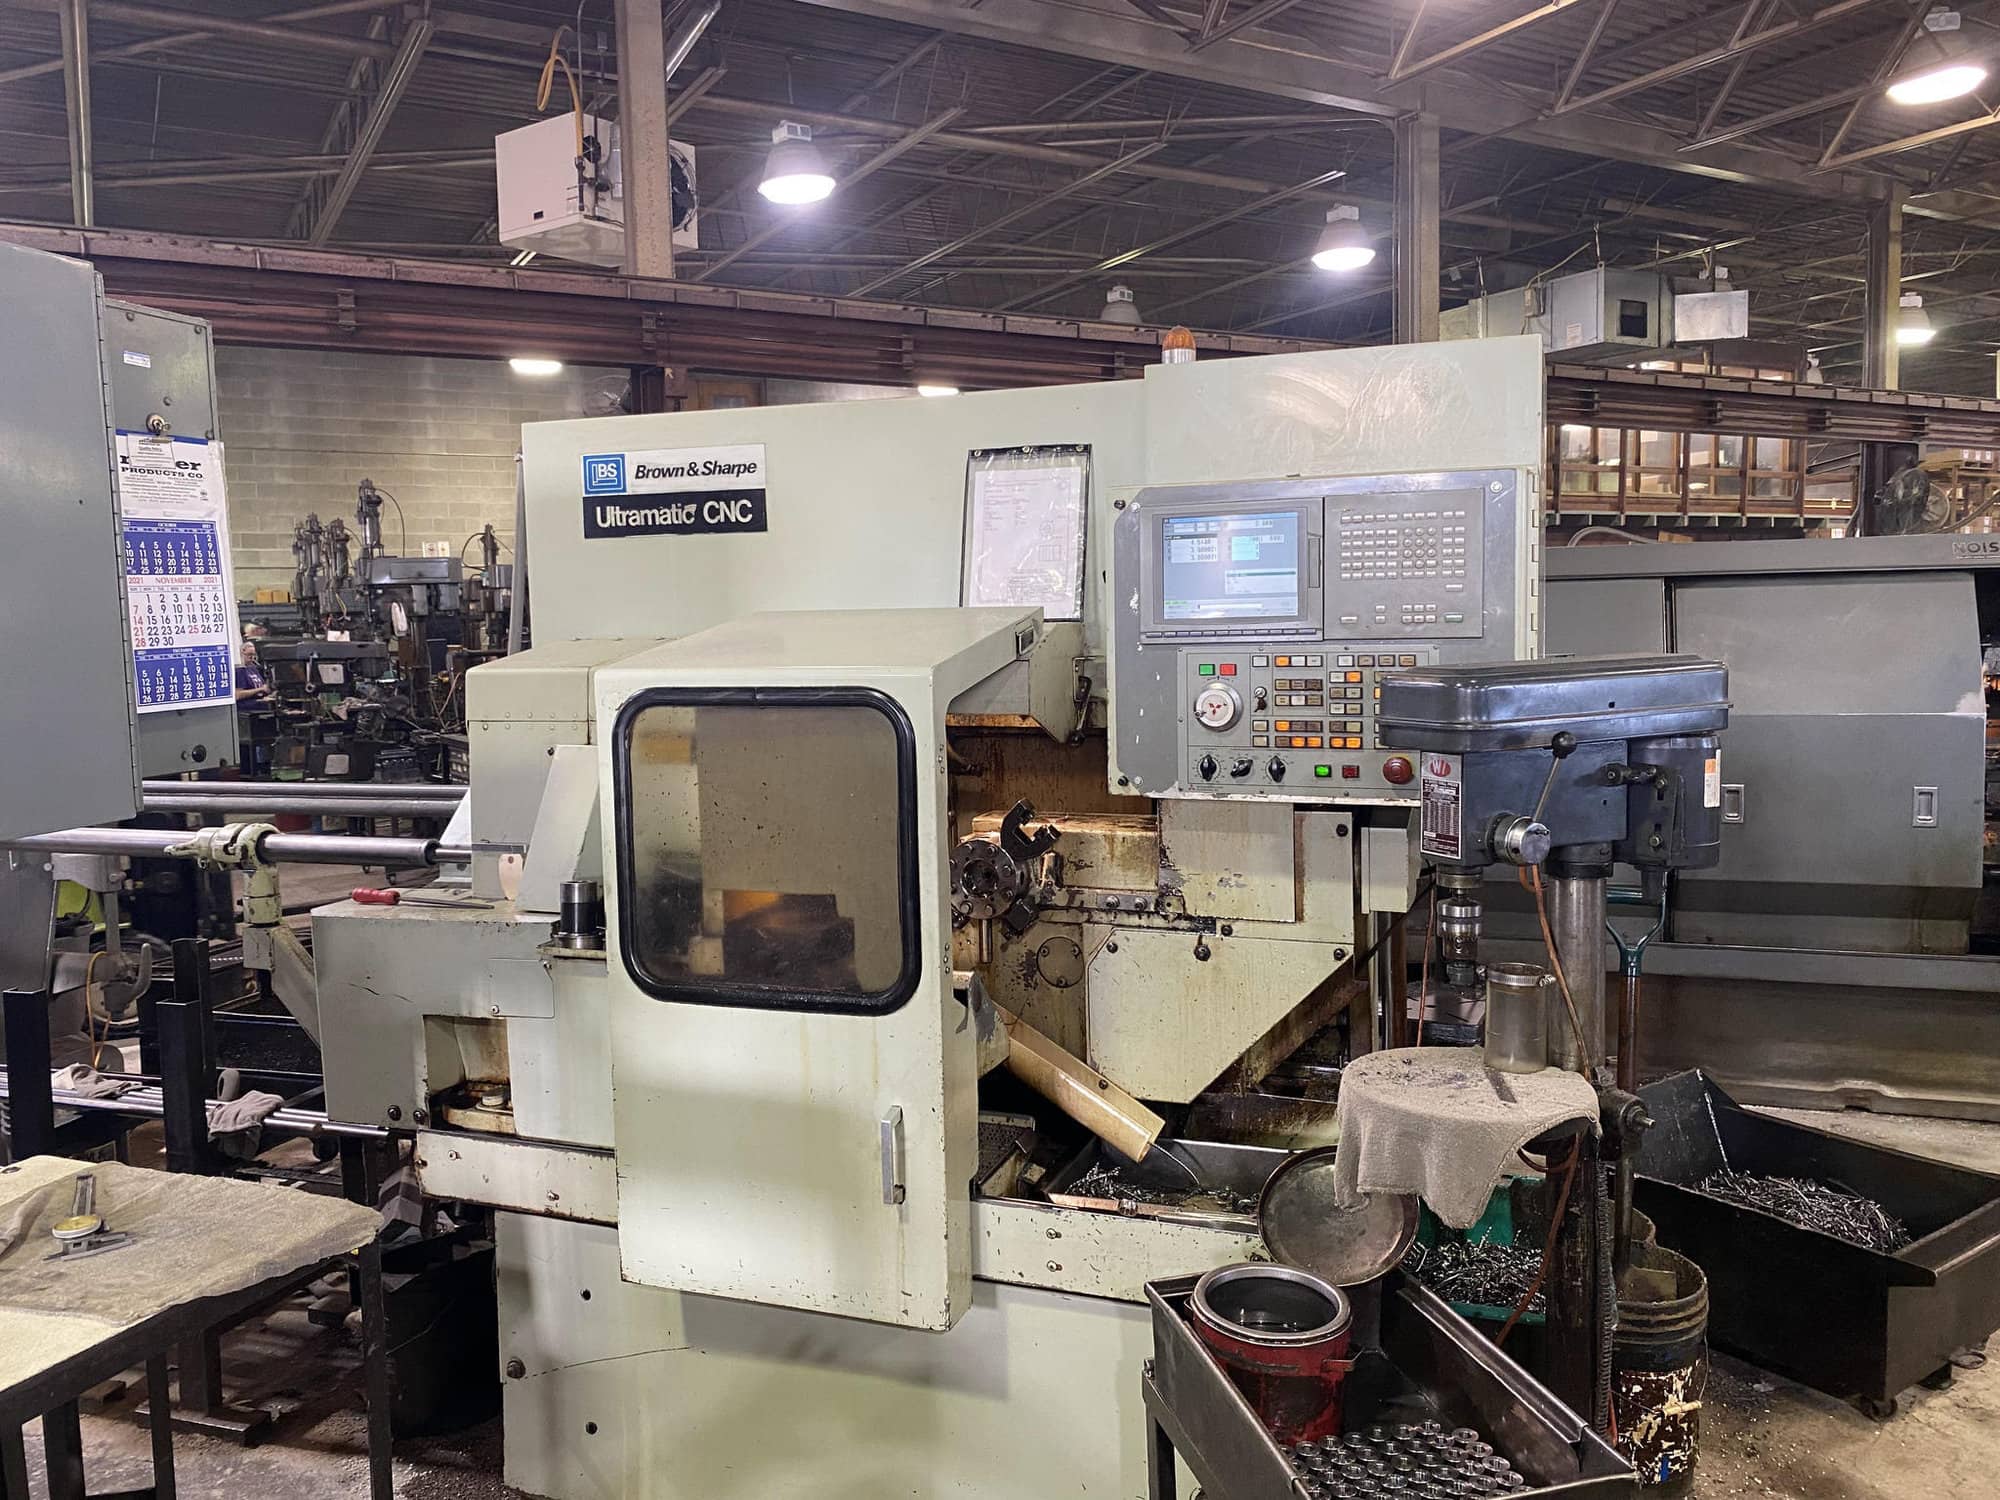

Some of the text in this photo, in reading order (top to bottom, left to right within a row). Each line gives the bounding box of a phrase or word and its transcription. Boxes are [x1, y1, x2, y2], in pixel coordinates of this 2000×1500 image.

[121, 467, 184, 477] PRODUCTS
[635, 461, 757, 479] Brown & Sharpe
[596, 500, 752, 528] Ultramatic CNC
[146, 593, 219, 603] 1 2 3 4 5 6
[133, 603, 222, 614] 7 8 9 10 11 12 13
[133, 614, 224, 625] 14 15 16 17 18 19 20
[134, 624, 224, 636] 21 22 23 24 25 26 27
[136, 637, 174, 647] 28 29 30
